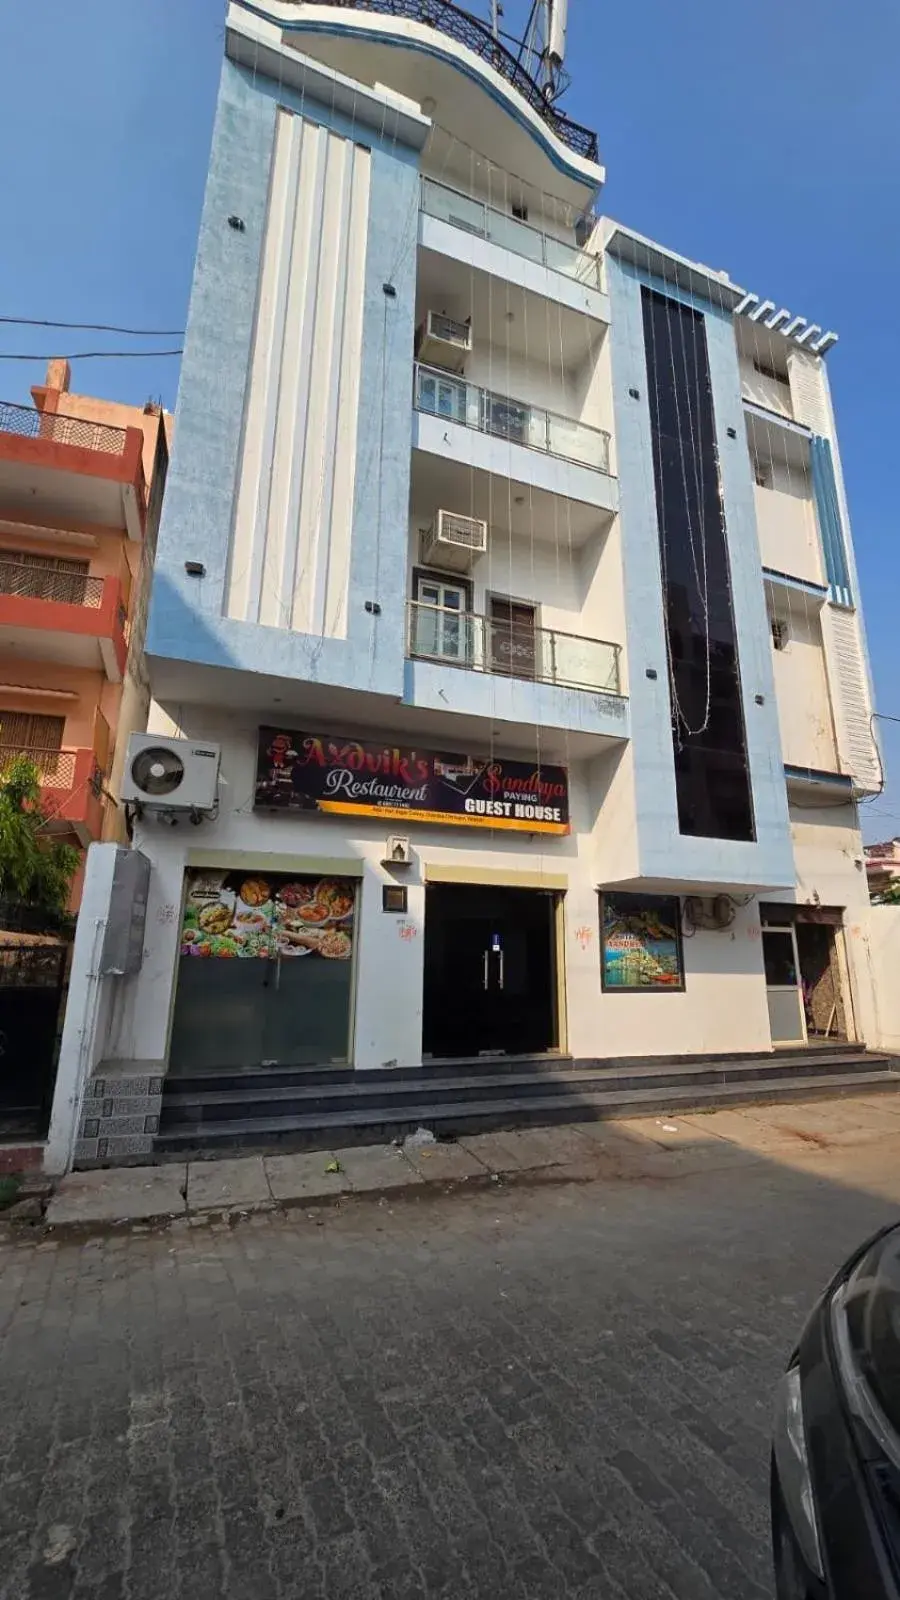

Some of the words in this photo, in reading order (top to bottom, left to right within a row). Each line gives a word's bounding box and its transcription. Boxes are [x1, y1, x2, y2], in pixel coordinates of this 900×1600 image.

[483, 763, 566, 802] Sandhya
[503, 791, 538, 802] PAYING
[464, 798, 512, 816] GUEST
[515, 804, 561, 821] HOUSE
